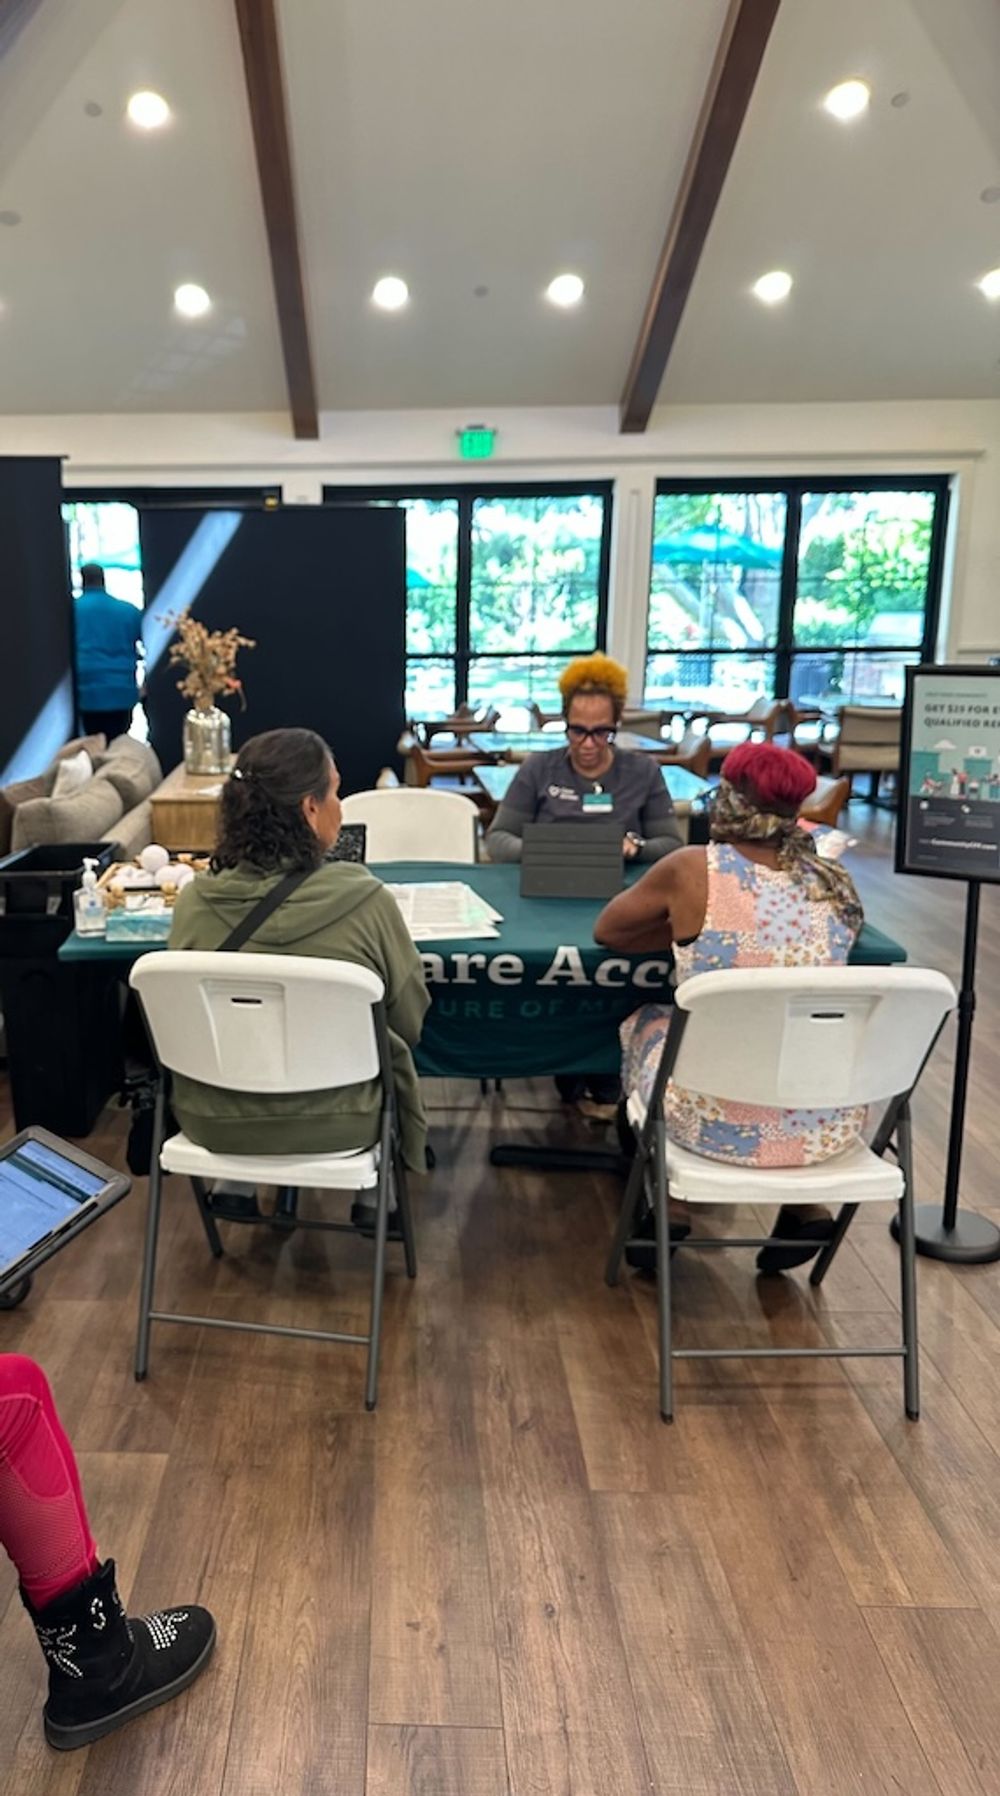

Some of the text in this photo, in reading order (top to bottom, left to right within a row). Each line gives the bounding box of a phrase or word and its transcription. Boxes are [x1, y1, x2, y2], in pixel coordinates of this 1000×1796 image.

[924, 703, 945, 713] GET
[967, 705, 989, 714] FOR
[992, 705, 1000, 715] E
[924, 716, 980, 728] QUALIFIED
[519, 999, 564, 1018] OF
